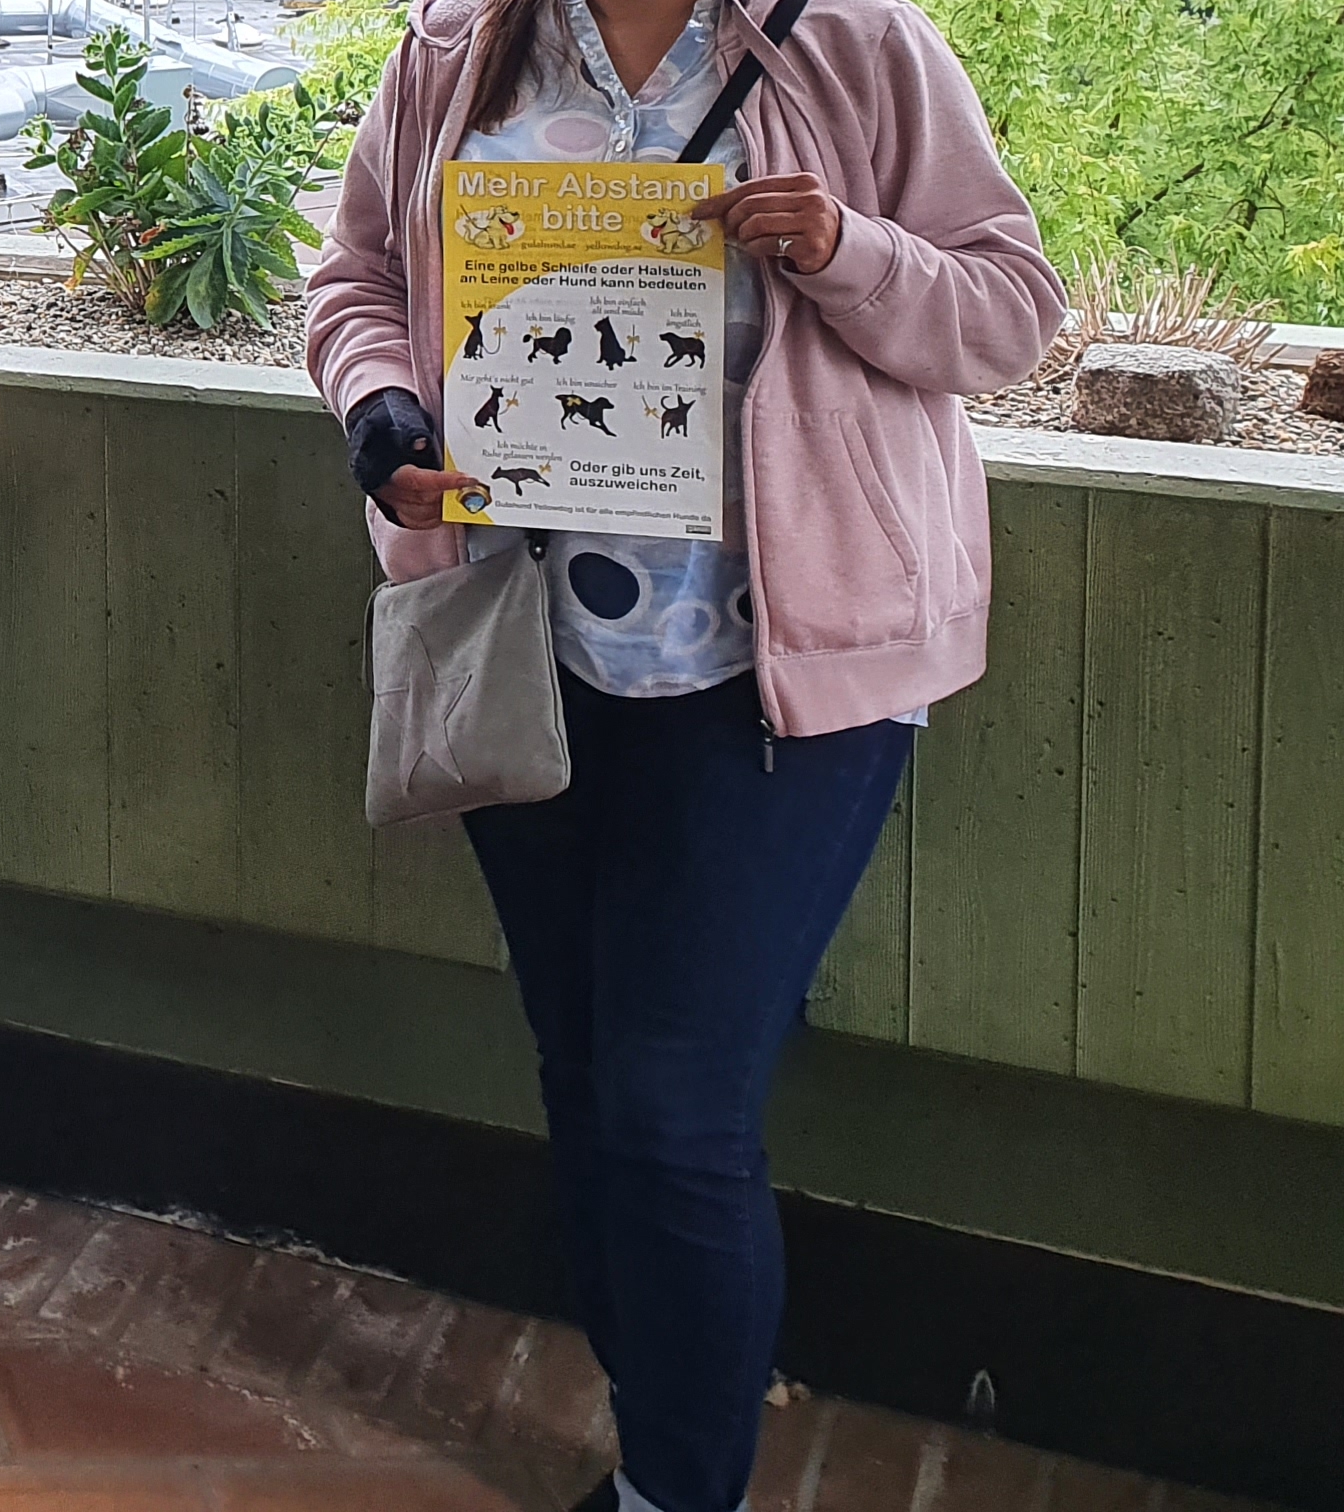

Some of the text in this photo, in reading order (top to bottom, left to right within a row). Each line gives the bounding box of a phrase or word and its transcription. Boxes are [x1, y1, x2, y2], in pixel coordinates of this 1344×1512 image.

[458, 171, 710, 200] Mehr Abstand
[542, 203, 623, 231] bitte
[464, 260, 702, 277] Eine gelbe Schleife oder Halstuch
[460, 273, 706, 290] an Leine oder Hund kann bedeuten
[590, 296, 602, 305] Ich
[526, 313, 537, 322] Ich
[670, 308, 682, 317] Ich
[556, 378, 568, 387] Ich
[569, 378, 582, 387] bin
[633, 381, 645, 390] Ich
[647, 380, 659, 391] bin
[497, 440, 509, 449] Ich
[569, 460, 705, 482] Oder gib uns Zeit,
[569, 476, 678, 493] auszuweichen
